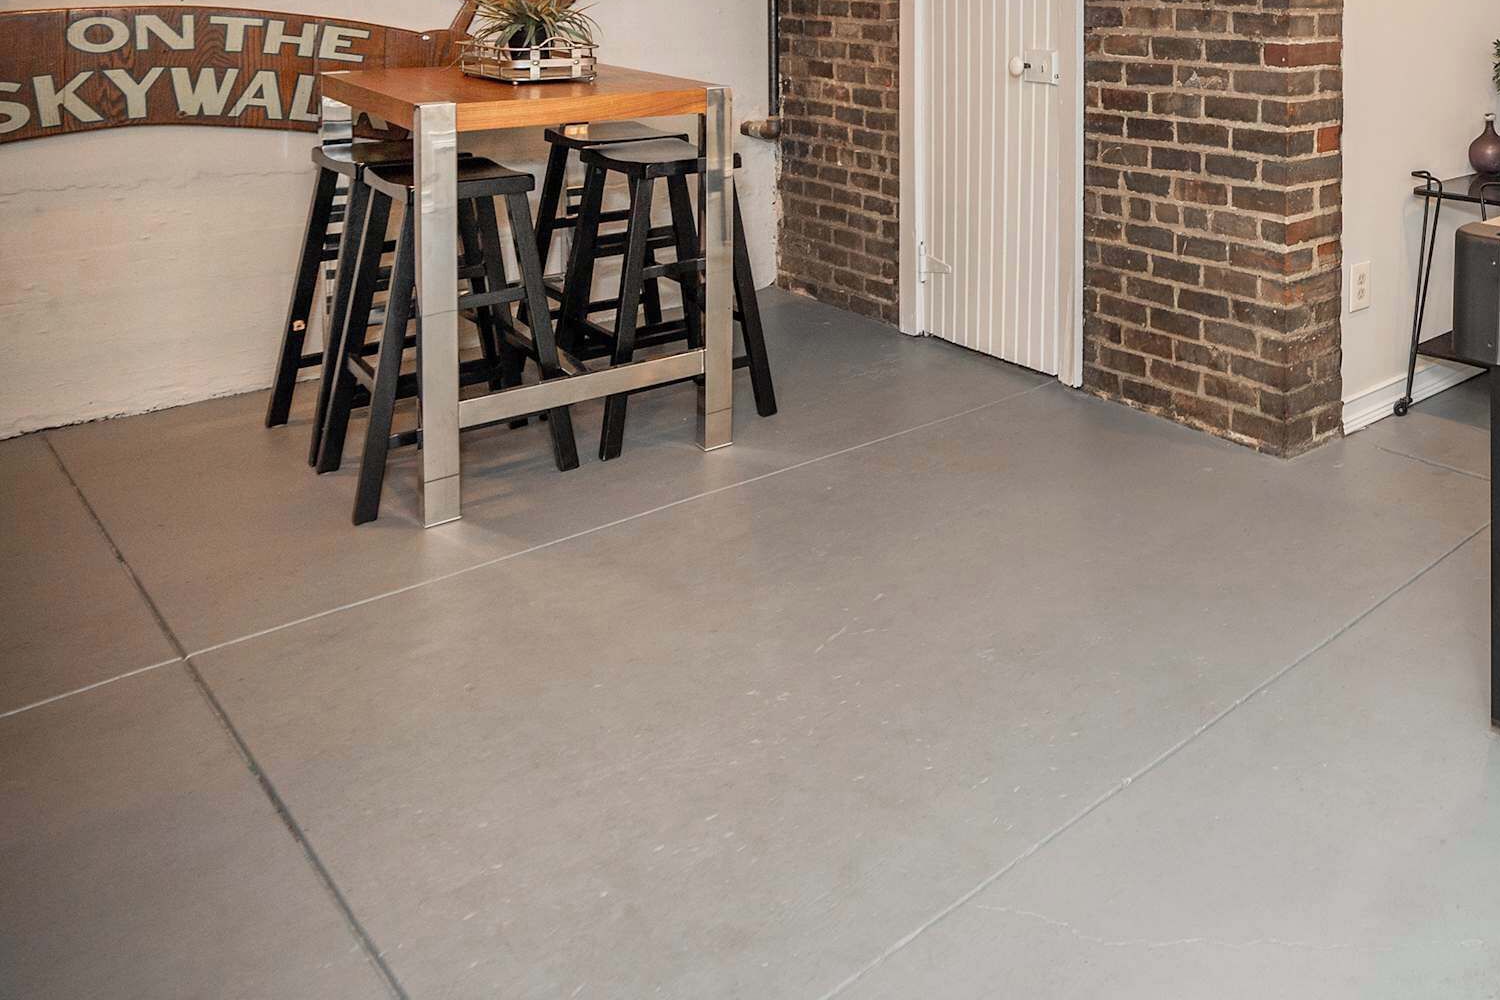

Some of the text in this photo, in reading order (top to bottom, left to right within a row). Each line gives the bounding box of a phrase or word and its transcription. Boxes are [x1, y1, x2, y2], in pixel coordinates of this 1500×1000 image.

[66, 14, 371, 63] ON THE
[0, 66, 388, 136] SKYWAL
